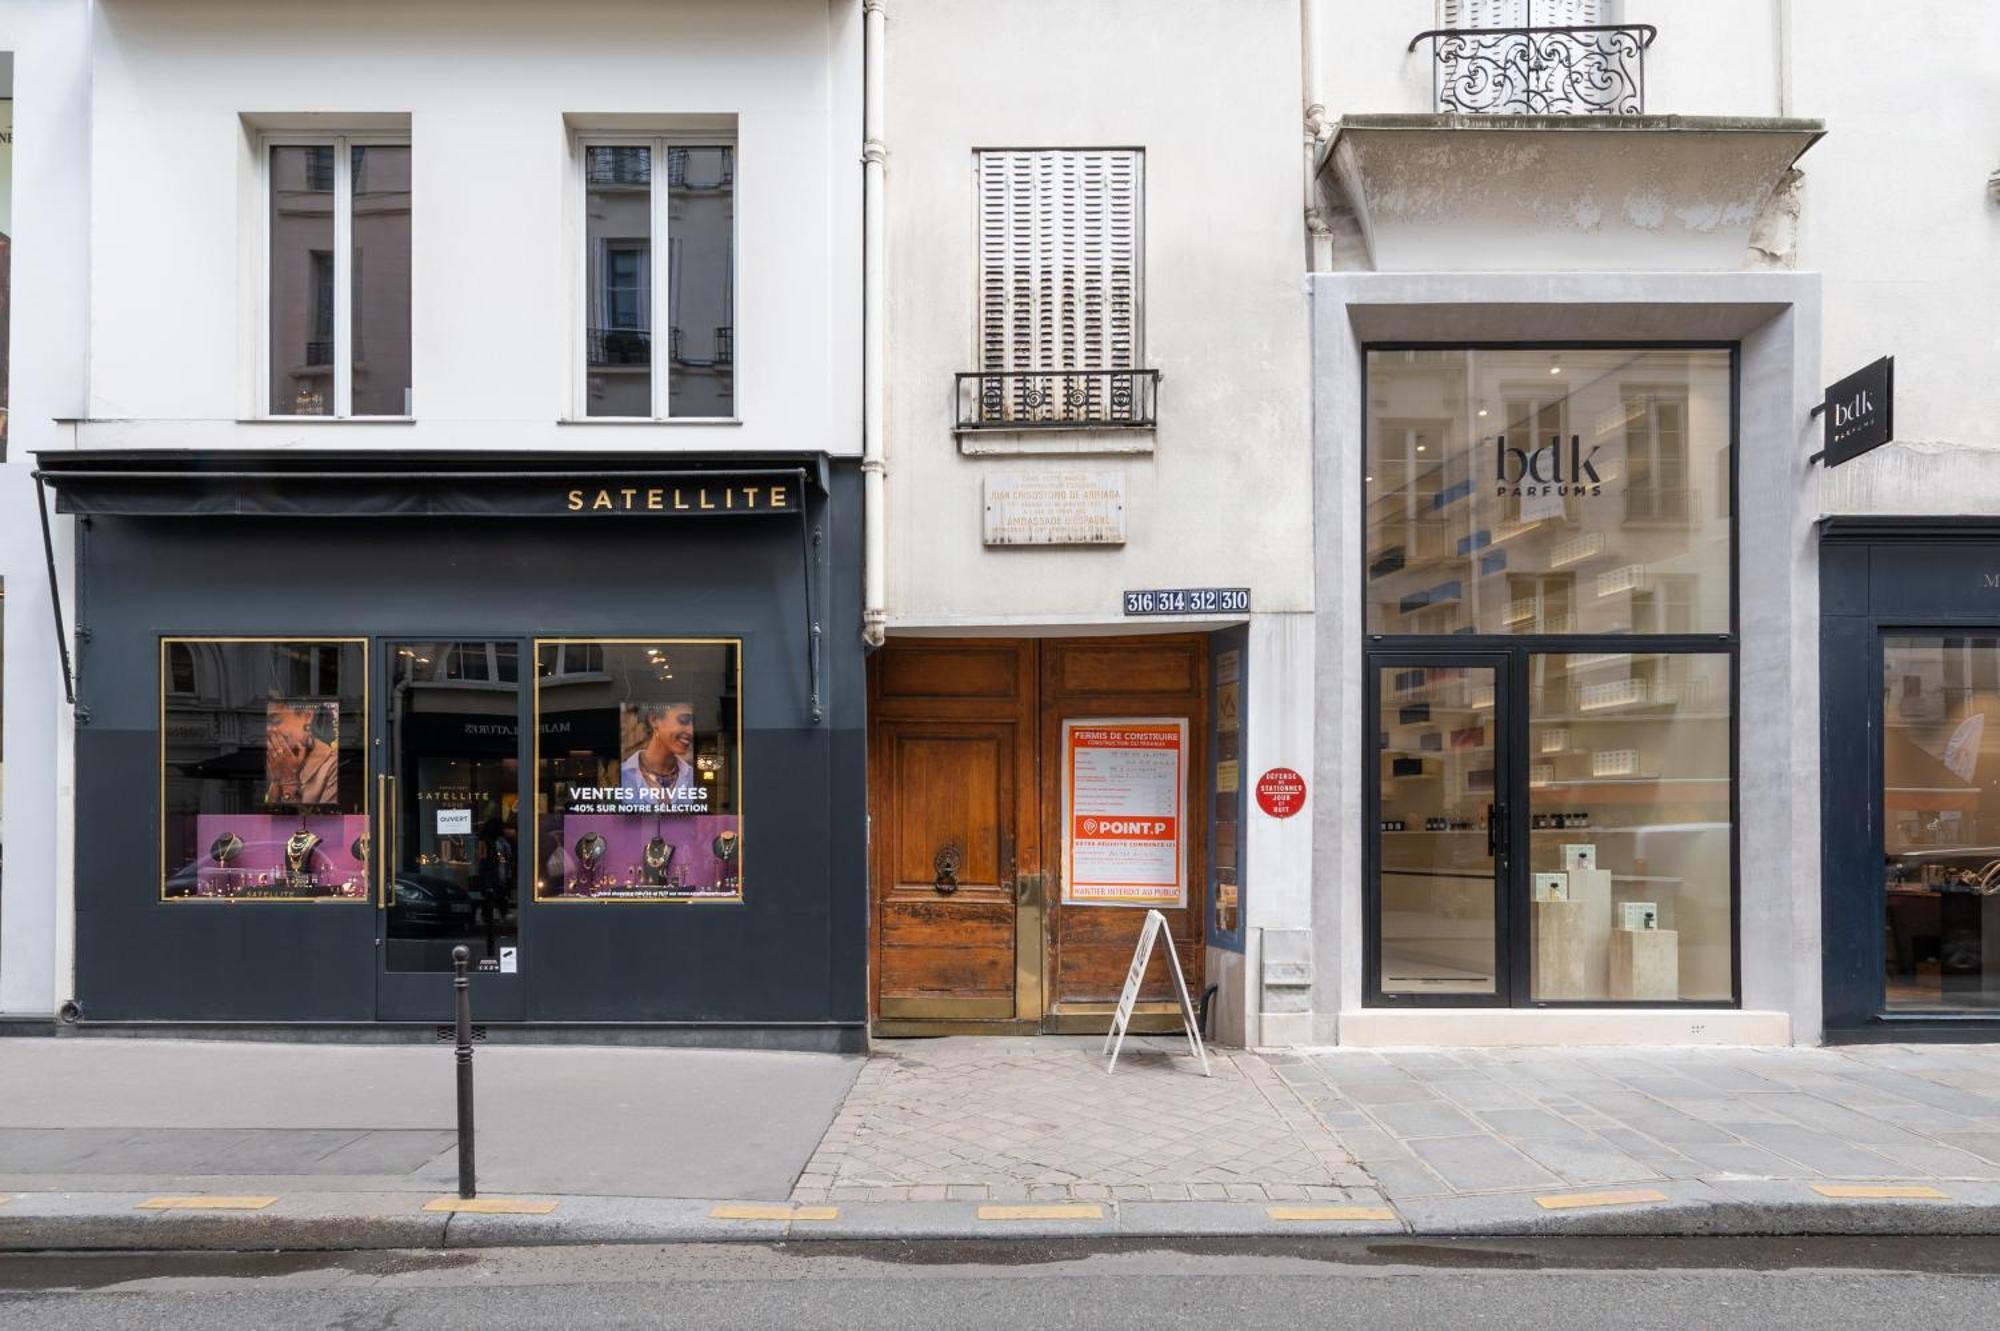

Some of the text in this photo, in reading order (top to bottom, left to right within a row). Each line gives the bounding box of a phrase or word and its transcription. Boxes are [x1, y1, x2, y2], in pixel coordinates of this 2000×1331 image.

[1835, 389, 1874, 427] bdk
[1497, 434, 1601, 484] bdk
[1497, 486, 1601, 497] PARFUMS
[567, 486, 786, 511] SATELLITE
[1127, 591, 1248, 612] 316 314 312 310
[1074, 731, 1179, 742] PERMIS DE CONSTRUIRE
[569, 784, 708, 800] VENTES PRIVÉES
[1260, 784, 1303, 792] STATIONNER
[417, 792, 489, 800] SATELLITE
[569, 802, 708, 813] -40% SUR NOTRE SÉLECTION
[440, 815, 468, 823] OUVERT
[1099, 821, 1166, 835] POINT.P
